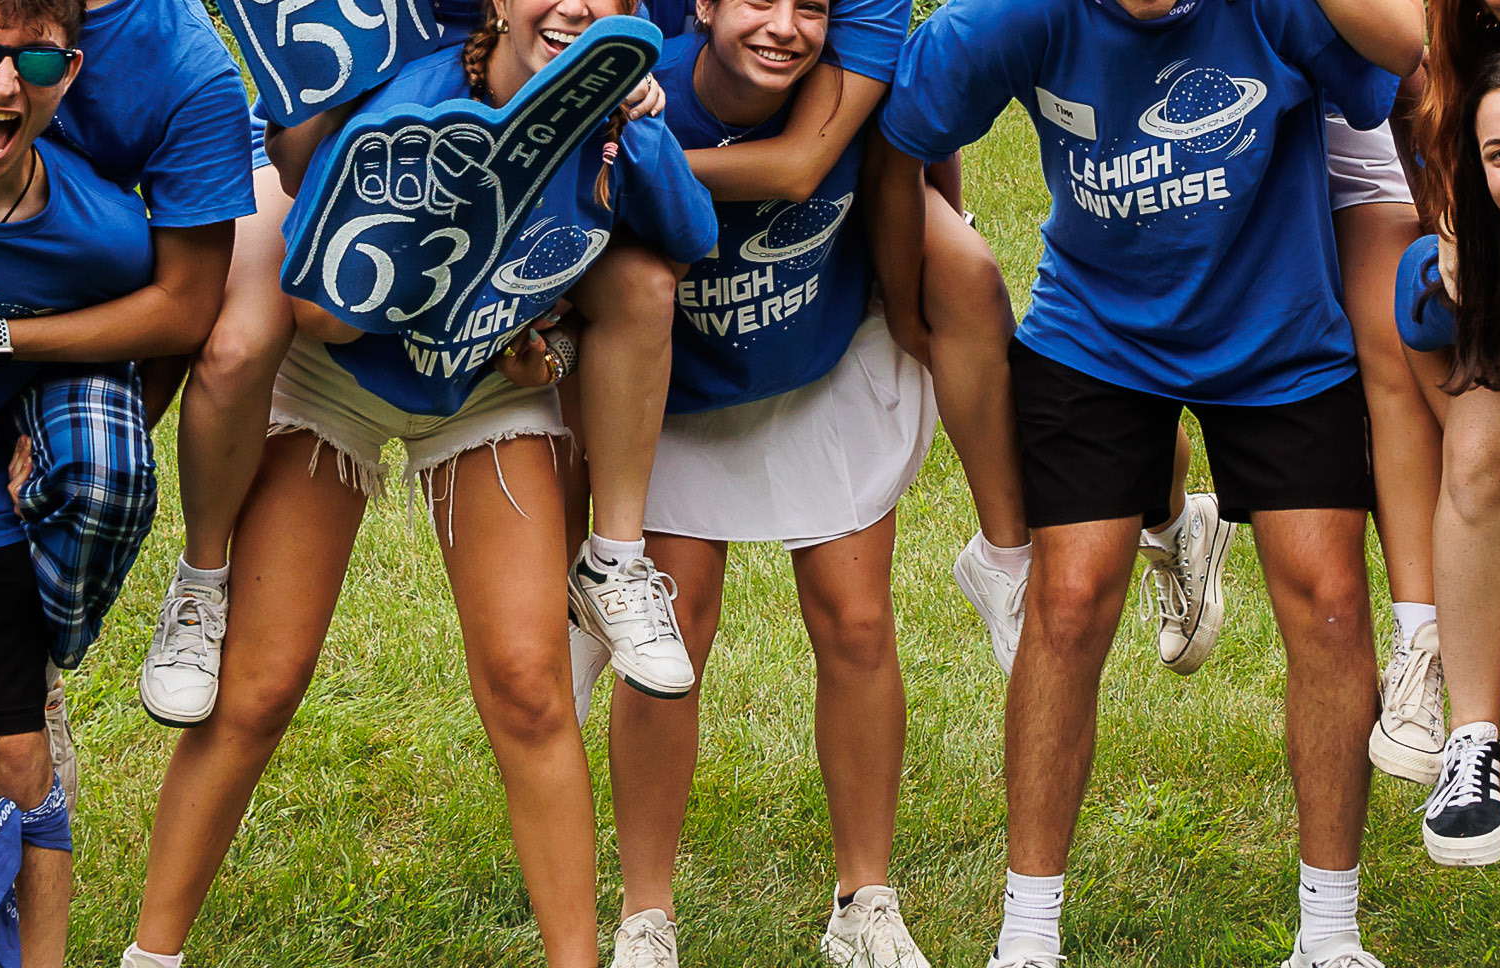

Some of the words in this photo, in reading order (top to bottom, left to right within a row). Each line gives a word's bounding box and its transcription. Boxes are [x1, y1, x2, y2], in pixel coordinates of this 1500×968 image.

[508, 57, 618, 169] LEHIGH
[1158, 116, 1225, 136] ORIENTATION
[1069, 142, 1172, 190] LEHIGH
[1071, 167, 1231, 219] UNIVERSE
[322, 213, 472, 322] 63
[676, 265, 774, 308] EHIGH
[681, 273, 819, 336] NIVERSE
